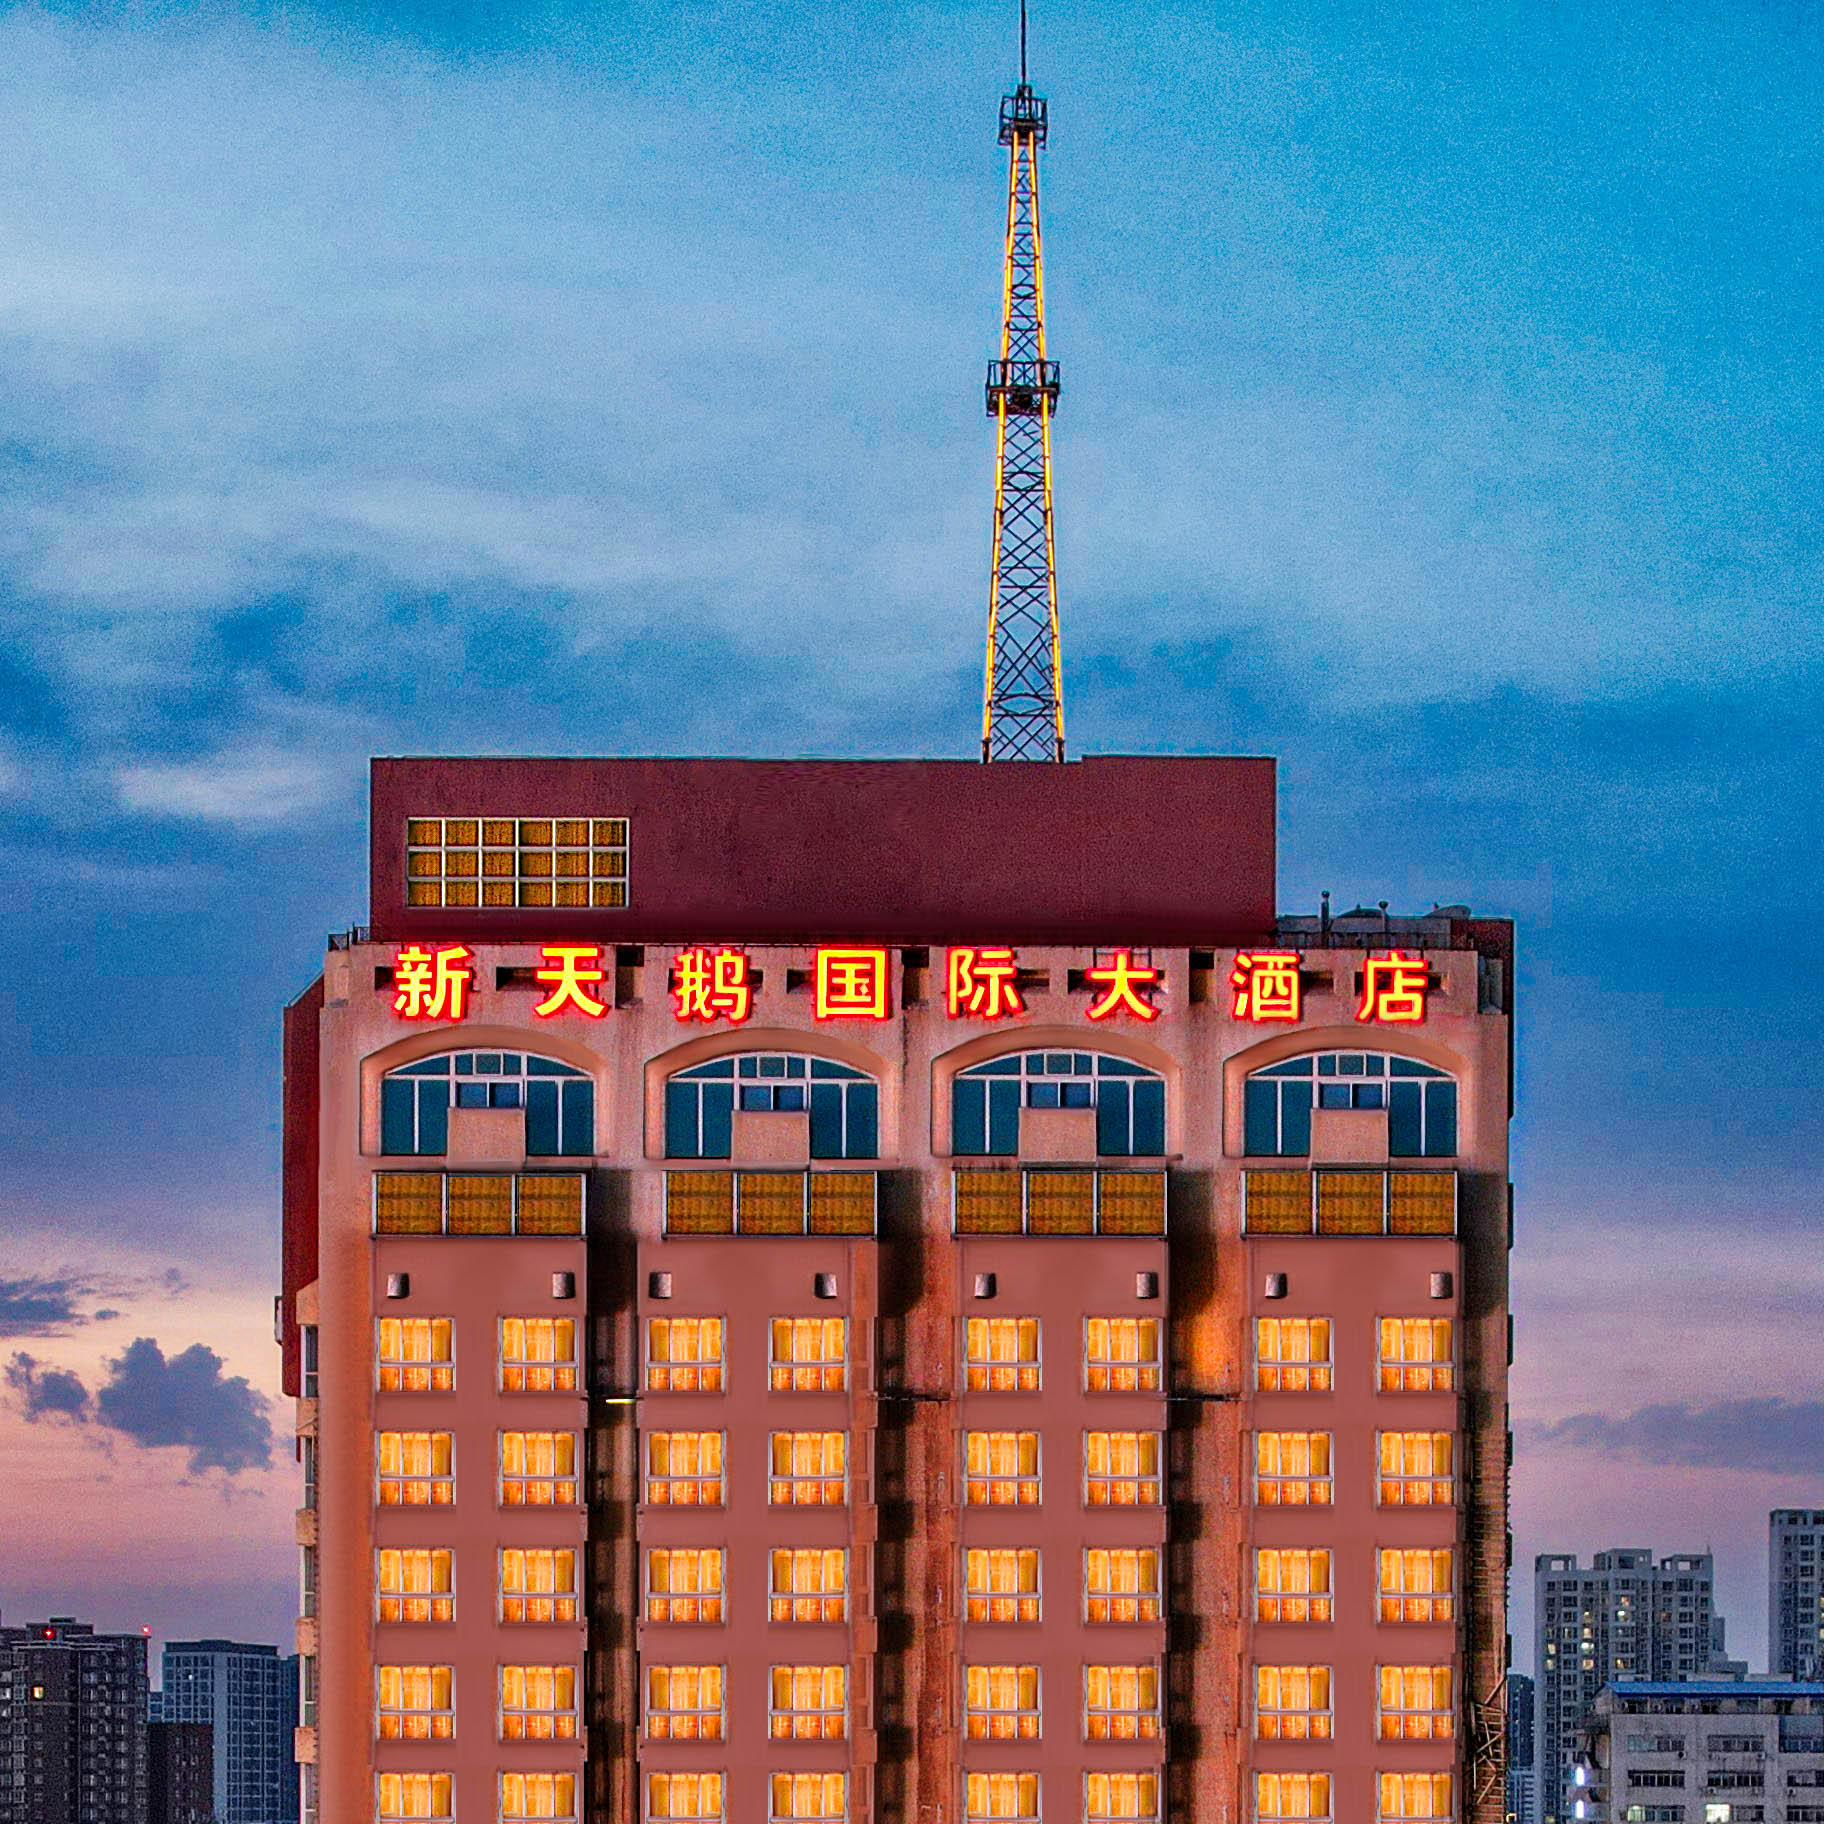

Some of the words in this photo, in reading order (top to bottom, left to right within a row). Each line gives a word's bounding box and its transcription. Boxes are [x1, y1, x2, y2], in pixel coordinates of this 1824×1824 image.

[394, 945, 1432, 1022] 新天鹅国际大酒店
